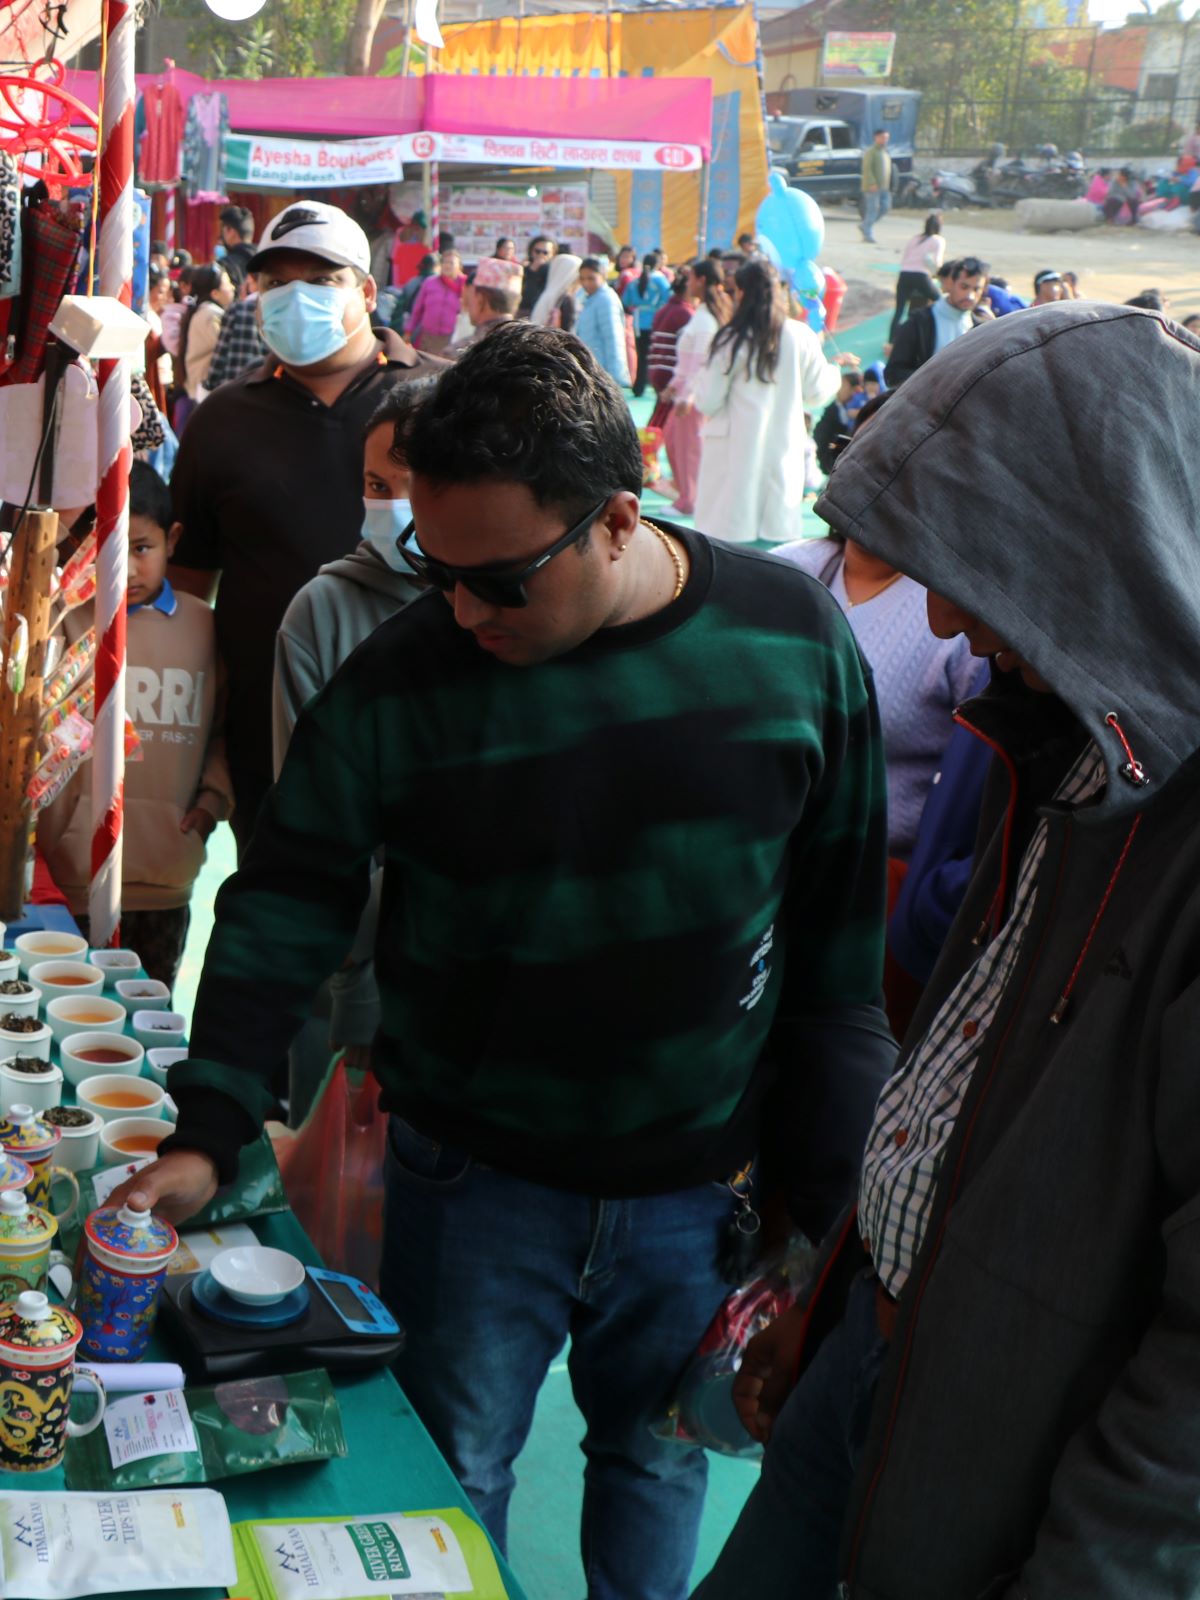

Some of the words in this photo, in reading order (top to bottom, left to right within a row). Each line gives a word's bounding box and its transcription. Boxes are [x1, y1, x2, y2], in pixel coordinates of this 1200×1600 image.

[252, 144, 311, 168] Ayesha
[252, 167, 336, 183] Bangladesh
[121, 1518, 136, 1544] TIPS
[364, 1545, 390, 1581] SILVER
[383, 1540, 404, 1573] RING
